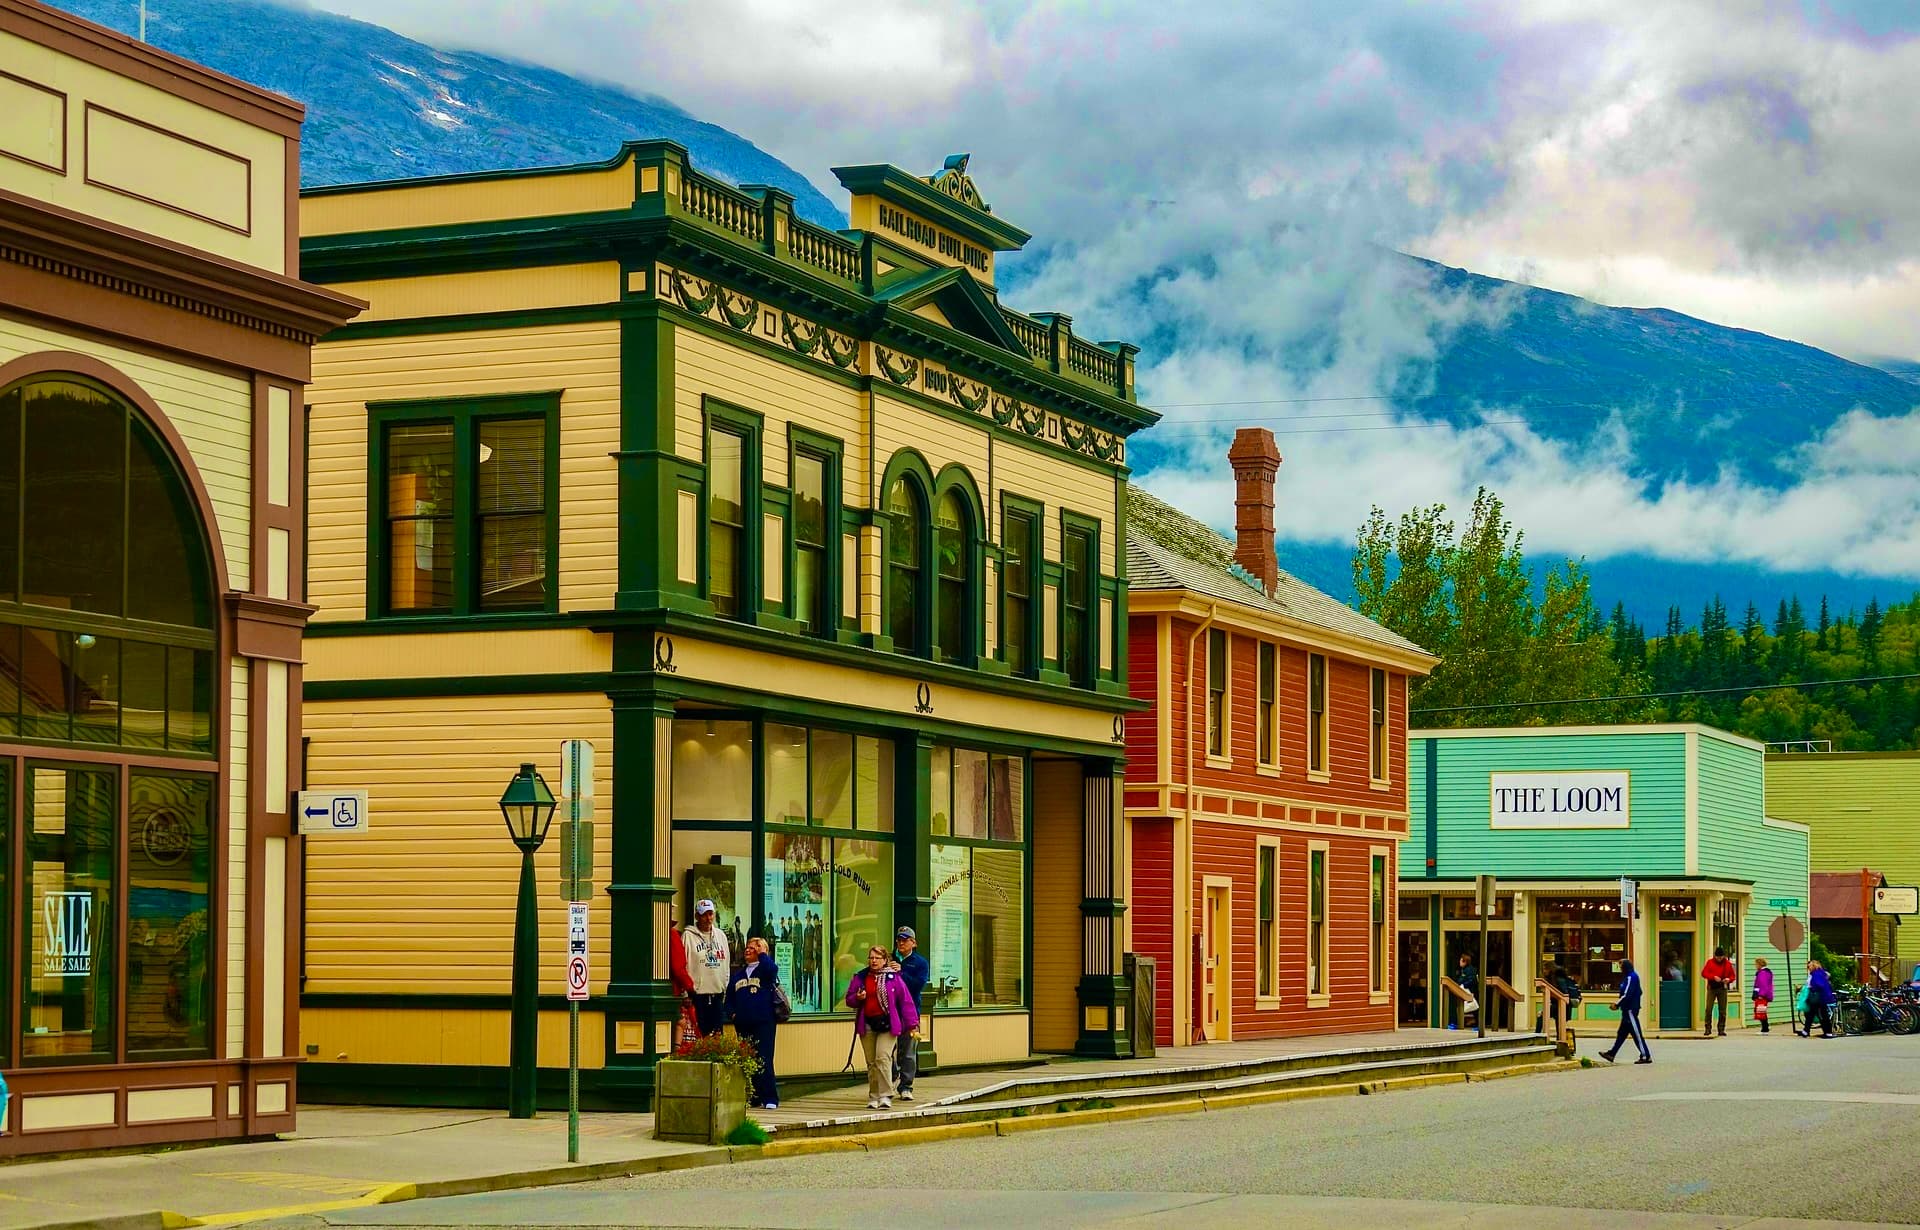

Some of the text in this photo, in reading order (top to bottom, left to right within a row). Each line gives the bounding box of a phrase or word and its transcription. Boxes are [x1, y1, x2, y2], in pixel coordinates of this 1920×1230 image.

[880, 204, 988, 272] RAILROAD BUILDING
[925, 367, 947, 393] 1900
[1495, 786, 1622, 813] THE LOOM
[833, 863, 852, 879] GOLD
[853, 871, 871, 896] RUSH
[932, 873, 959, 900] NATIONAL
[45, 896, 91, 956] SALE
[44, 958, 91, 971] SALE SALE
